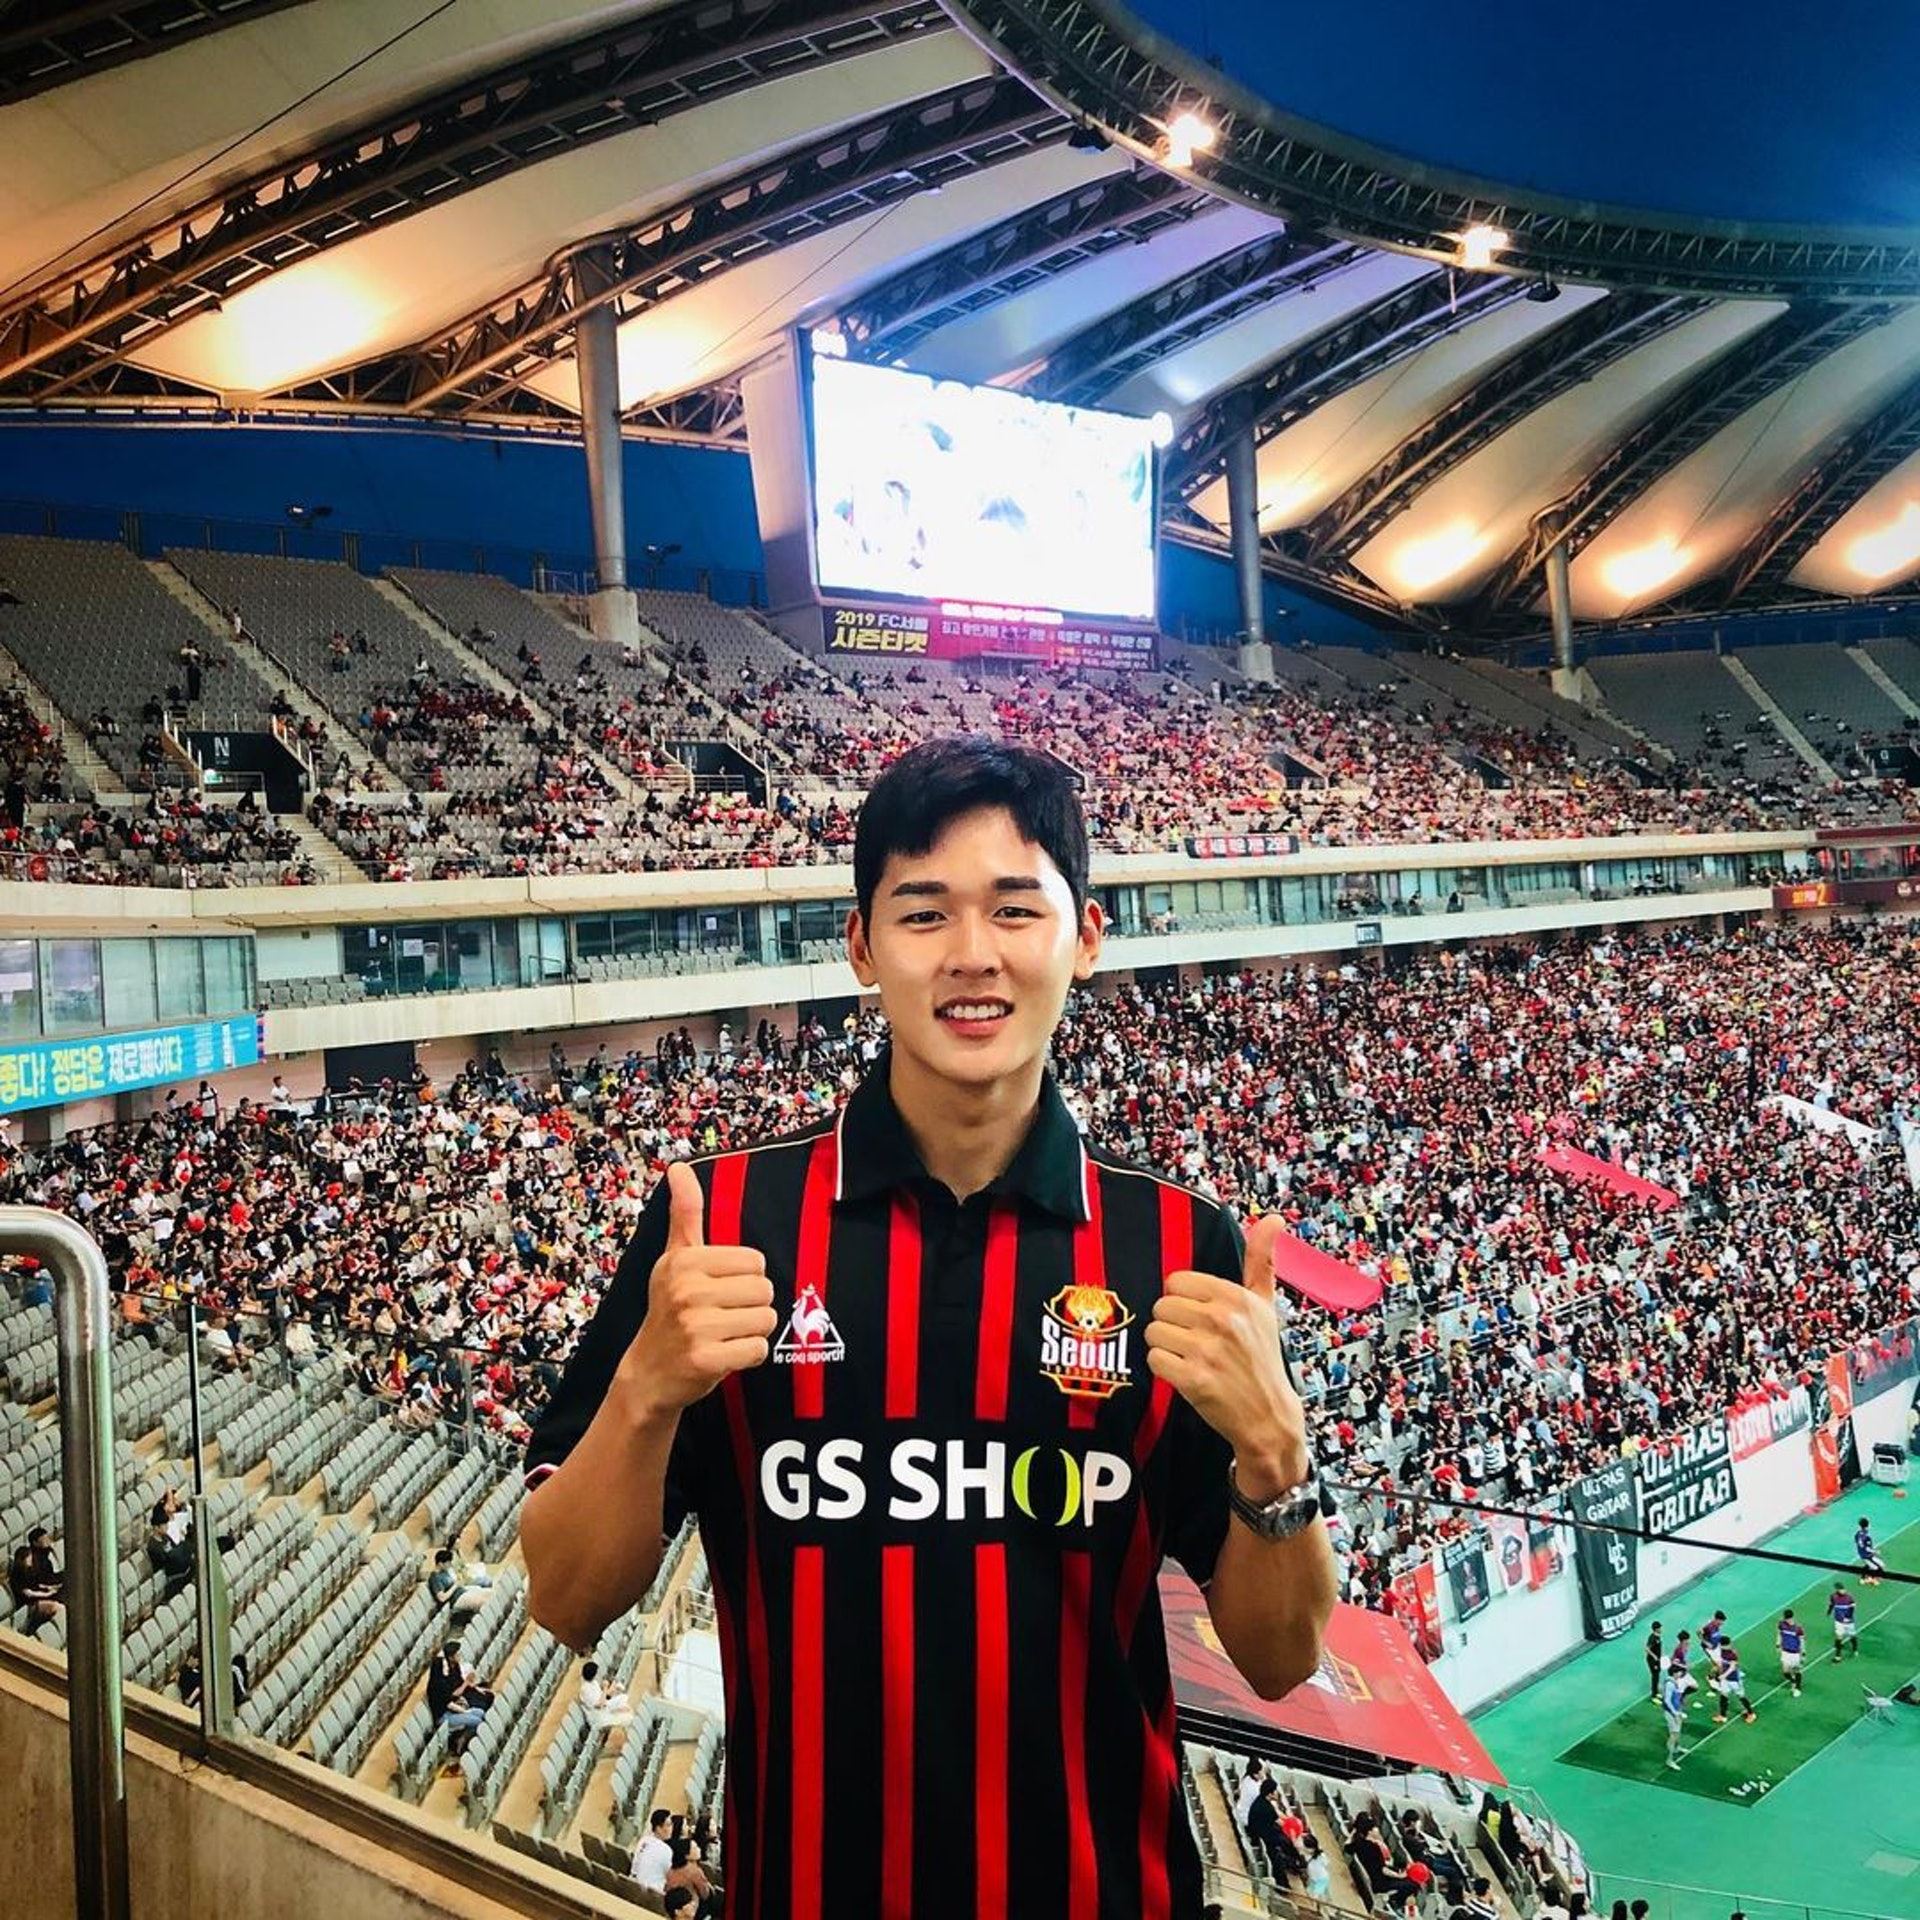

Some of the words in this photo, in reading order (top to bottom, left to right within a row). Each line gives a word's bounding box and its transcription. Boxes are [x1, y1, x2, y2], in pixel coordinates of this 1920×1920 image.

[835, 610, 876, 626] 2019
[214, 737, 229, 757] N
[51, 1045, 105, 1094] 정답은
[773, 1349, 783, 1364] le
[785, 1351, 806, 1365] coq
[1041, 1314, 1132, 1374] Seoul
[1640, 1418, 1726, 1484] ULTRAS
[760, 1438, 867, 1521] GS
[888, 1438, 1132, 1528] SHOP
[1648, 1468, 1731, 1535] GRITAR
